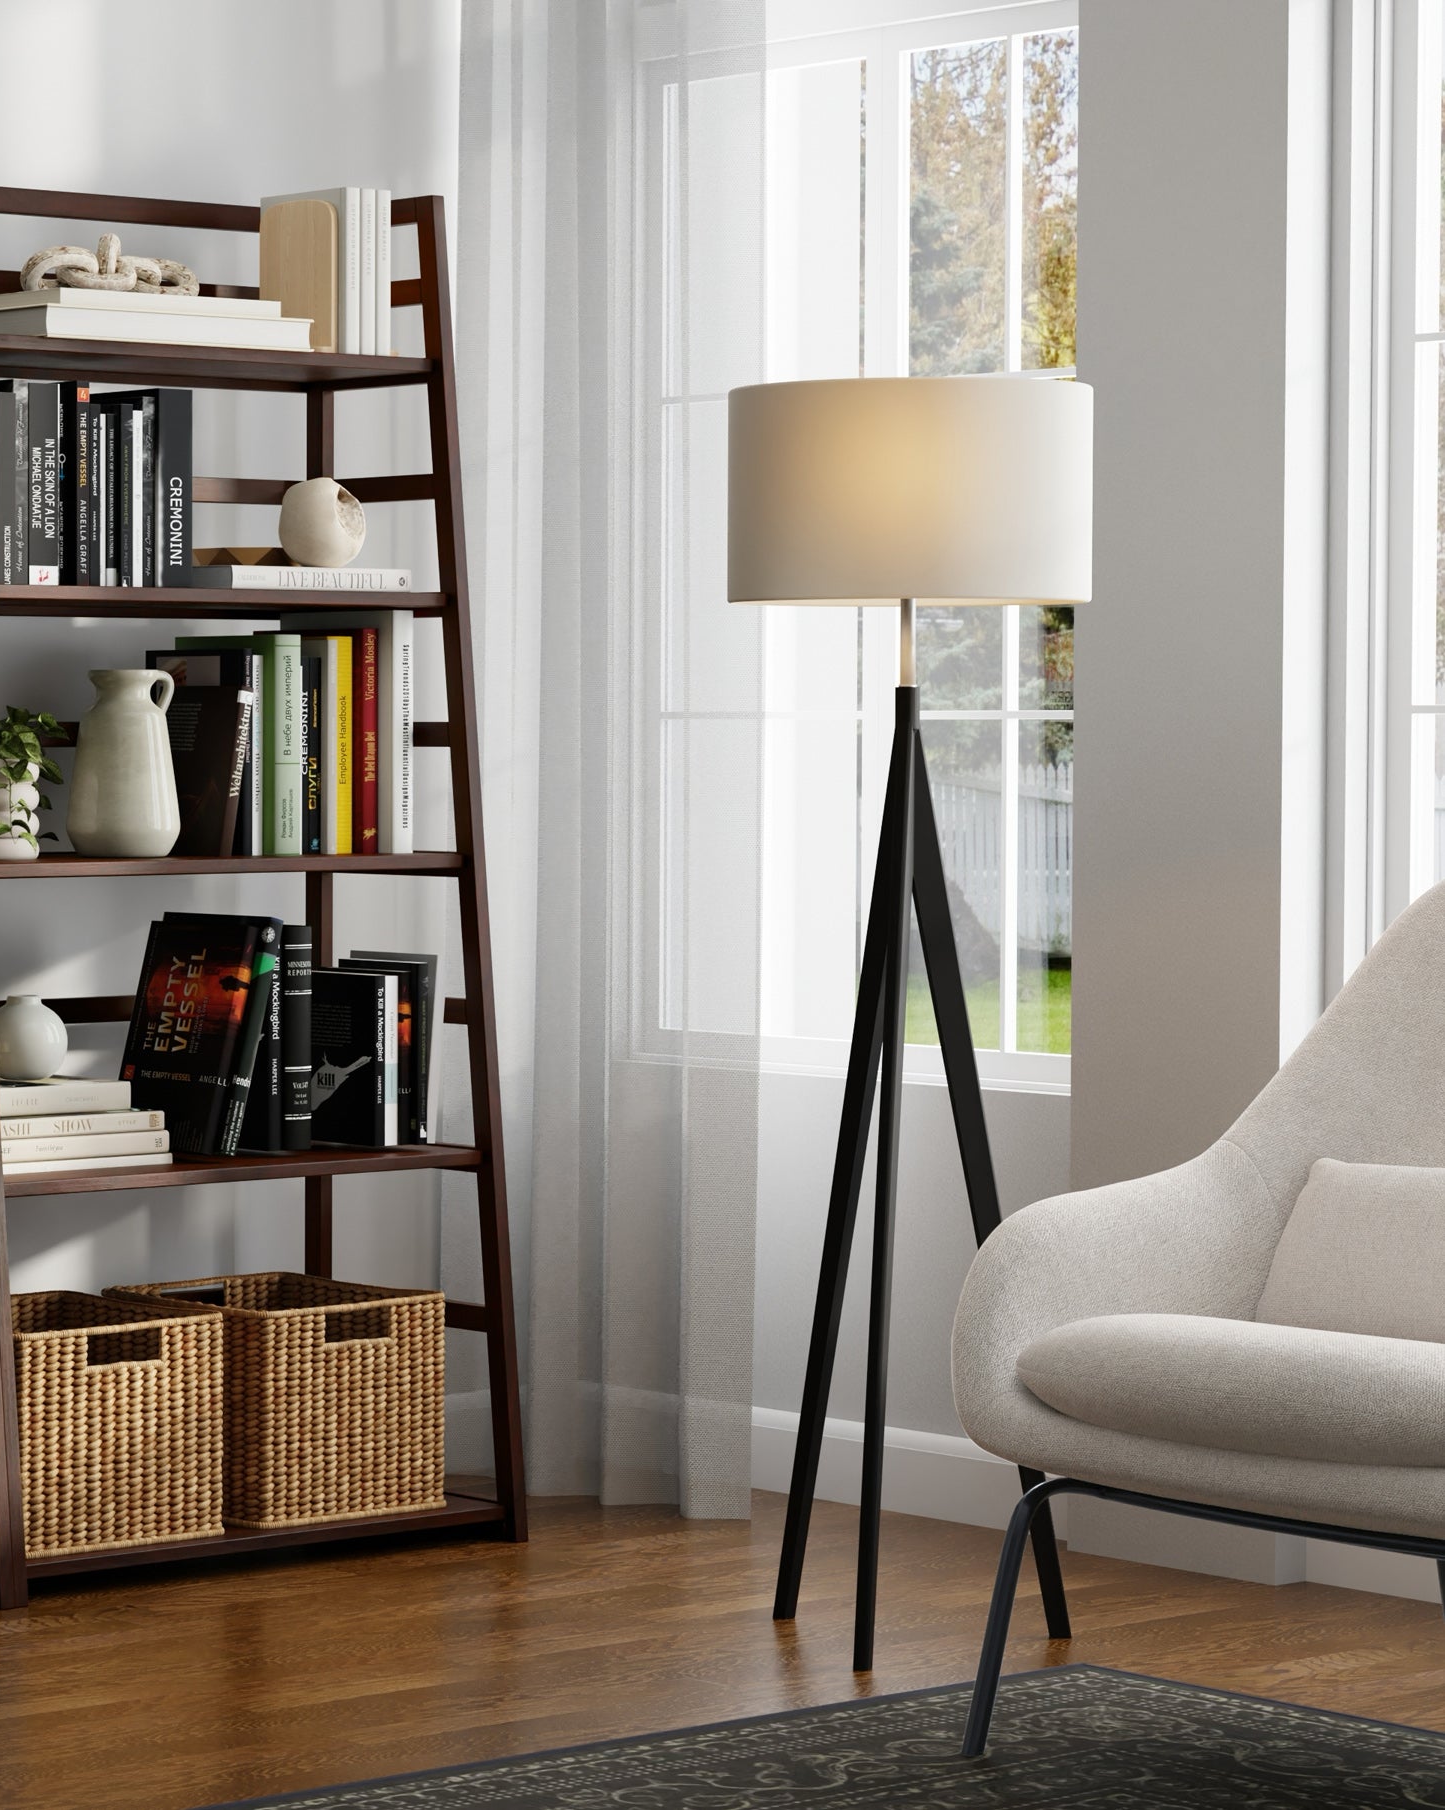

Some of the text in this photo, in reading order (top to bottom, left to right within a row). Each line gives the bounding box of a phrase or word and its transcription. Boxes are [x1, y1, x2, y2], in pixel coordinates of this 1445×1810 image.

[92, 417, 98, 427] To
[44, 438, 55, 448] IN
[44, 449, 55, 469] THE
[108, 463, 115, 471] OF
[31, 447, 42, 529] MICHAEL ONDAATJE
[44, 470, 55, 492] SKIN
[44, 493, 55, 506] OF
[44, 516, 55, 539] LION
[169, 476, 183, 566] CREMONINI
[3, 525, 12, 567] CONSTRUCTION
[16, 540, 24, 572] House of
[278, 570, 387, 590] LIVE BEAUTIFUL
[283, 654, 293, 696] империй
[364, 632, 376, 700] Victoria Mosley
[283, 699, 293, 722] двух
[283, 723, 293, 747] небе
[339, 695, 348, 785] Employee Handbook
[229, 703, 253, 798] Weltarchitektur
[308, 757, 317, 810] СЛУГИ
[152, 956, 187, 1053] EMPTY
[169, 945, 208, 1054] VESSEL
[376, 987, 384, 998] To
[376, 998, 384, 1010] Kill
[271, 980, 280, 1040] Mockingbird
[142, 1020, 156, 1050] THE
[376, 1016, 384, 1062] Mockingbird
[141, 1070, 192, 1082] THE EMPTY VESSEL
[317, 1072, 335, 1086] kill
[53, 1119, 93, 1133] SHOW
